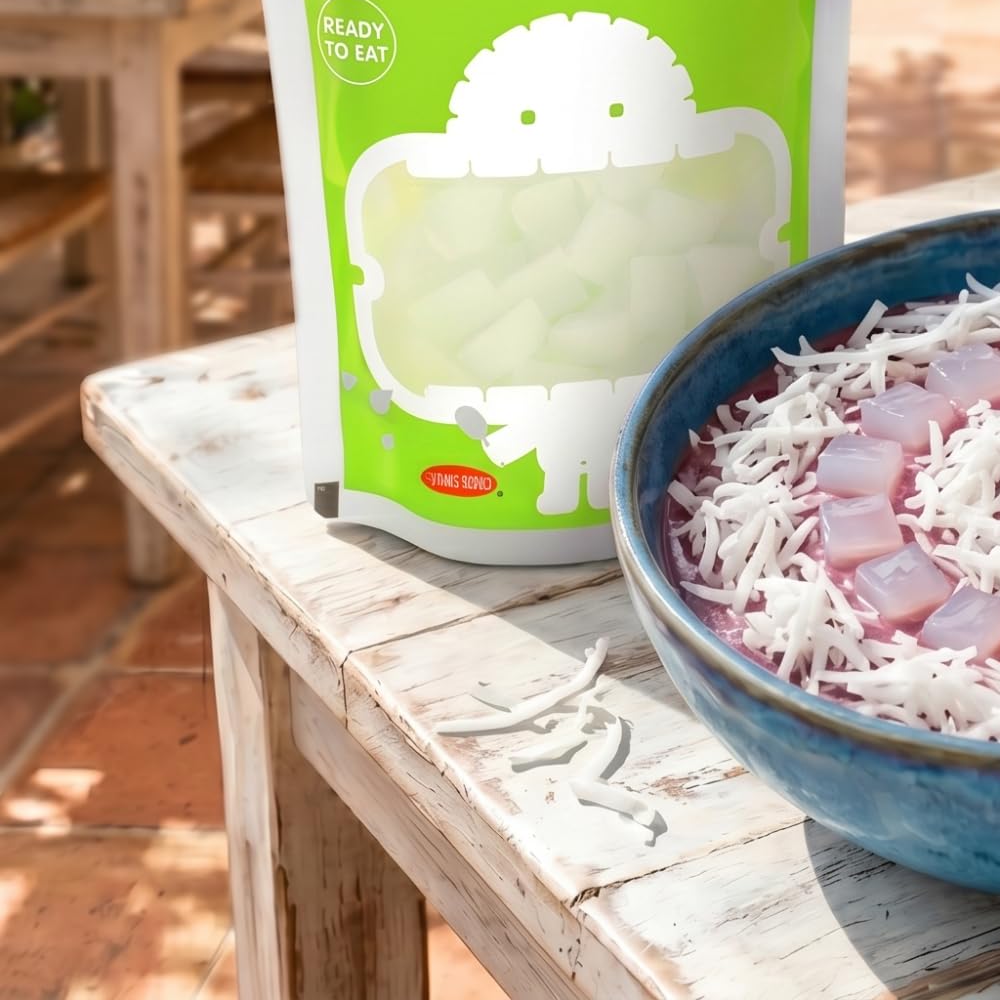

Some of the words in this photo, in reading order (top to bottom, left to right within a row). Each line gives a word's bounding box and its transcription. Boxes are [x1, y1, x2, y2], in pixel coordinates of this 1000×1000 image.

[323, 15, 385, 40] READY
[325, 40, 349, 60] TO
[354, 44, 389, 63] EAT
